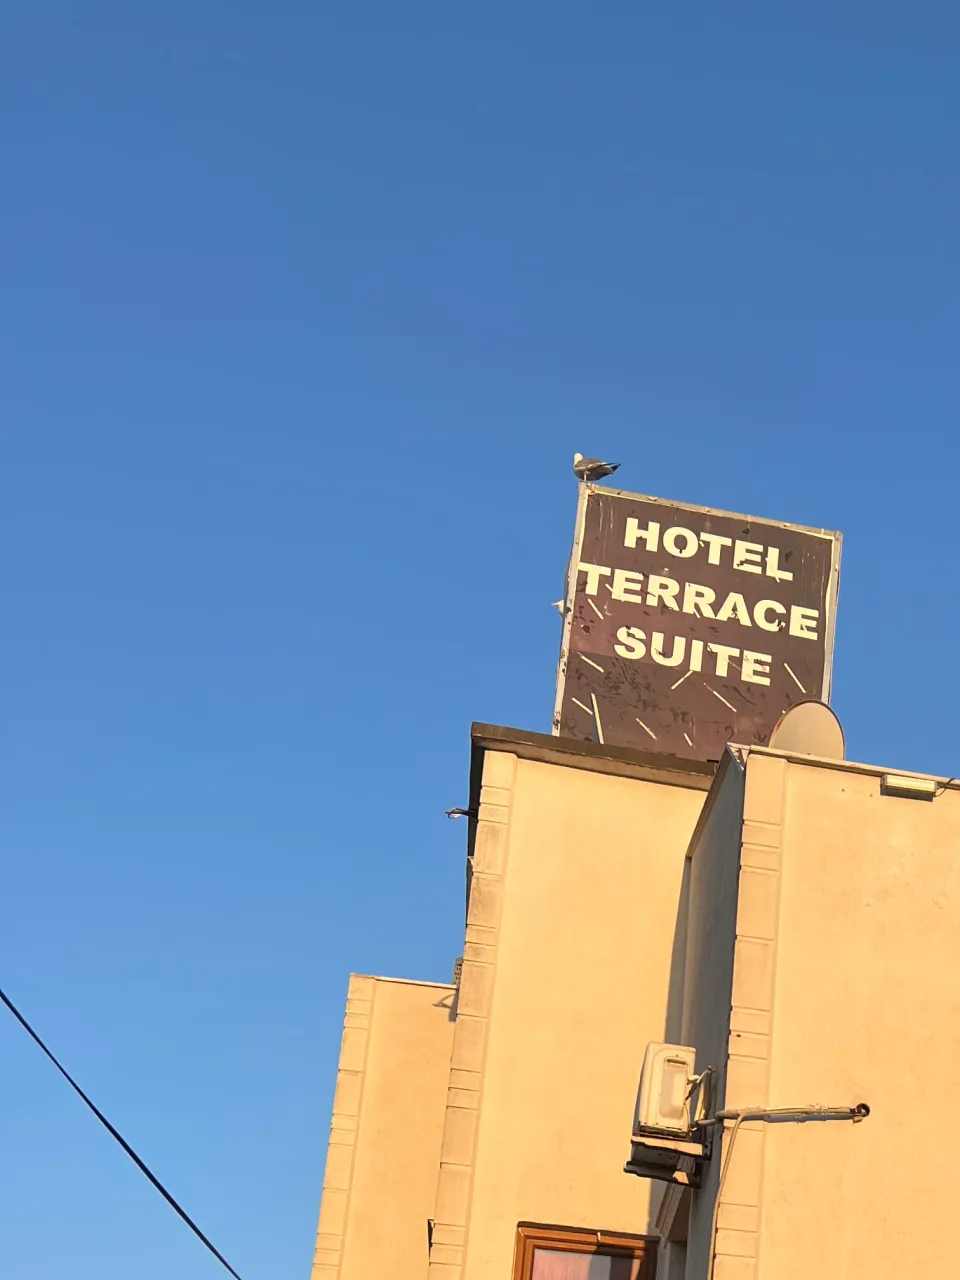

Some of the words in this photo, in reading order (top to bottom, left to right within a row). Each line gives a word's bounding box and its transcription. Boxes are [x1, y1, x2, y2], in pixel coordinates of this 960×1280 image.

[624, 517, 794, 582] HOTEL
[577, 562, 820, 640] TERRACE
[613, 626, 772, 686] SUITE
